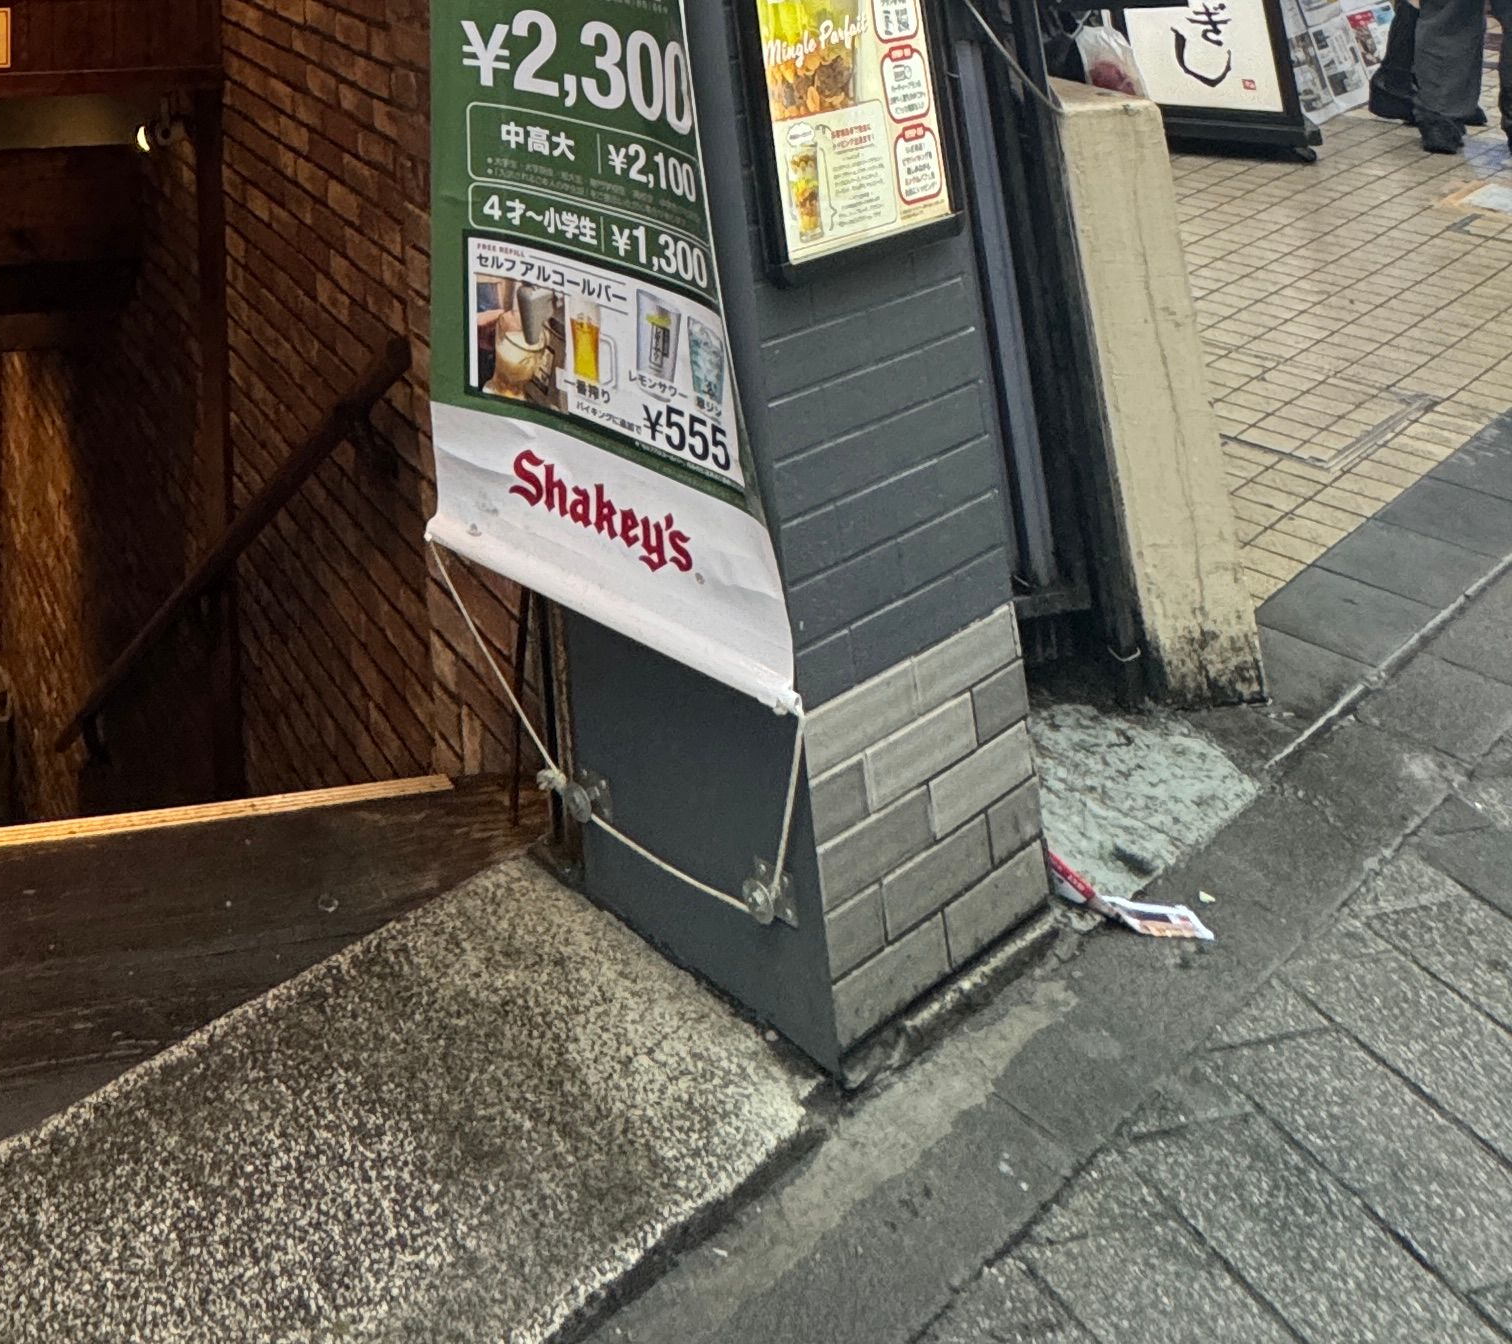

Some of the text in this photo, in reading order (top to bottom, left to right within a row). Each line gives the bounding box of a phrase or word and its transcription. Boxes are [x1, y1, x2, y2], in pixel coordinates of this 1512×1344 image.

[768, 14, 869, 69] Mingle Parfait
[460, 9, 693, 135] ¥2,300
[500, 121, 576, 161] 中高大
[607, 143, 697, 203] ¥2,100
[476, 242, 497, 253] FREE
[611, 225, 708, 290] ¥1,300
[628, 370, 688, 400] レモンサワー
[642, 404, 731, 471] ¥555
[509, 449, 694, 573] Shakey's
